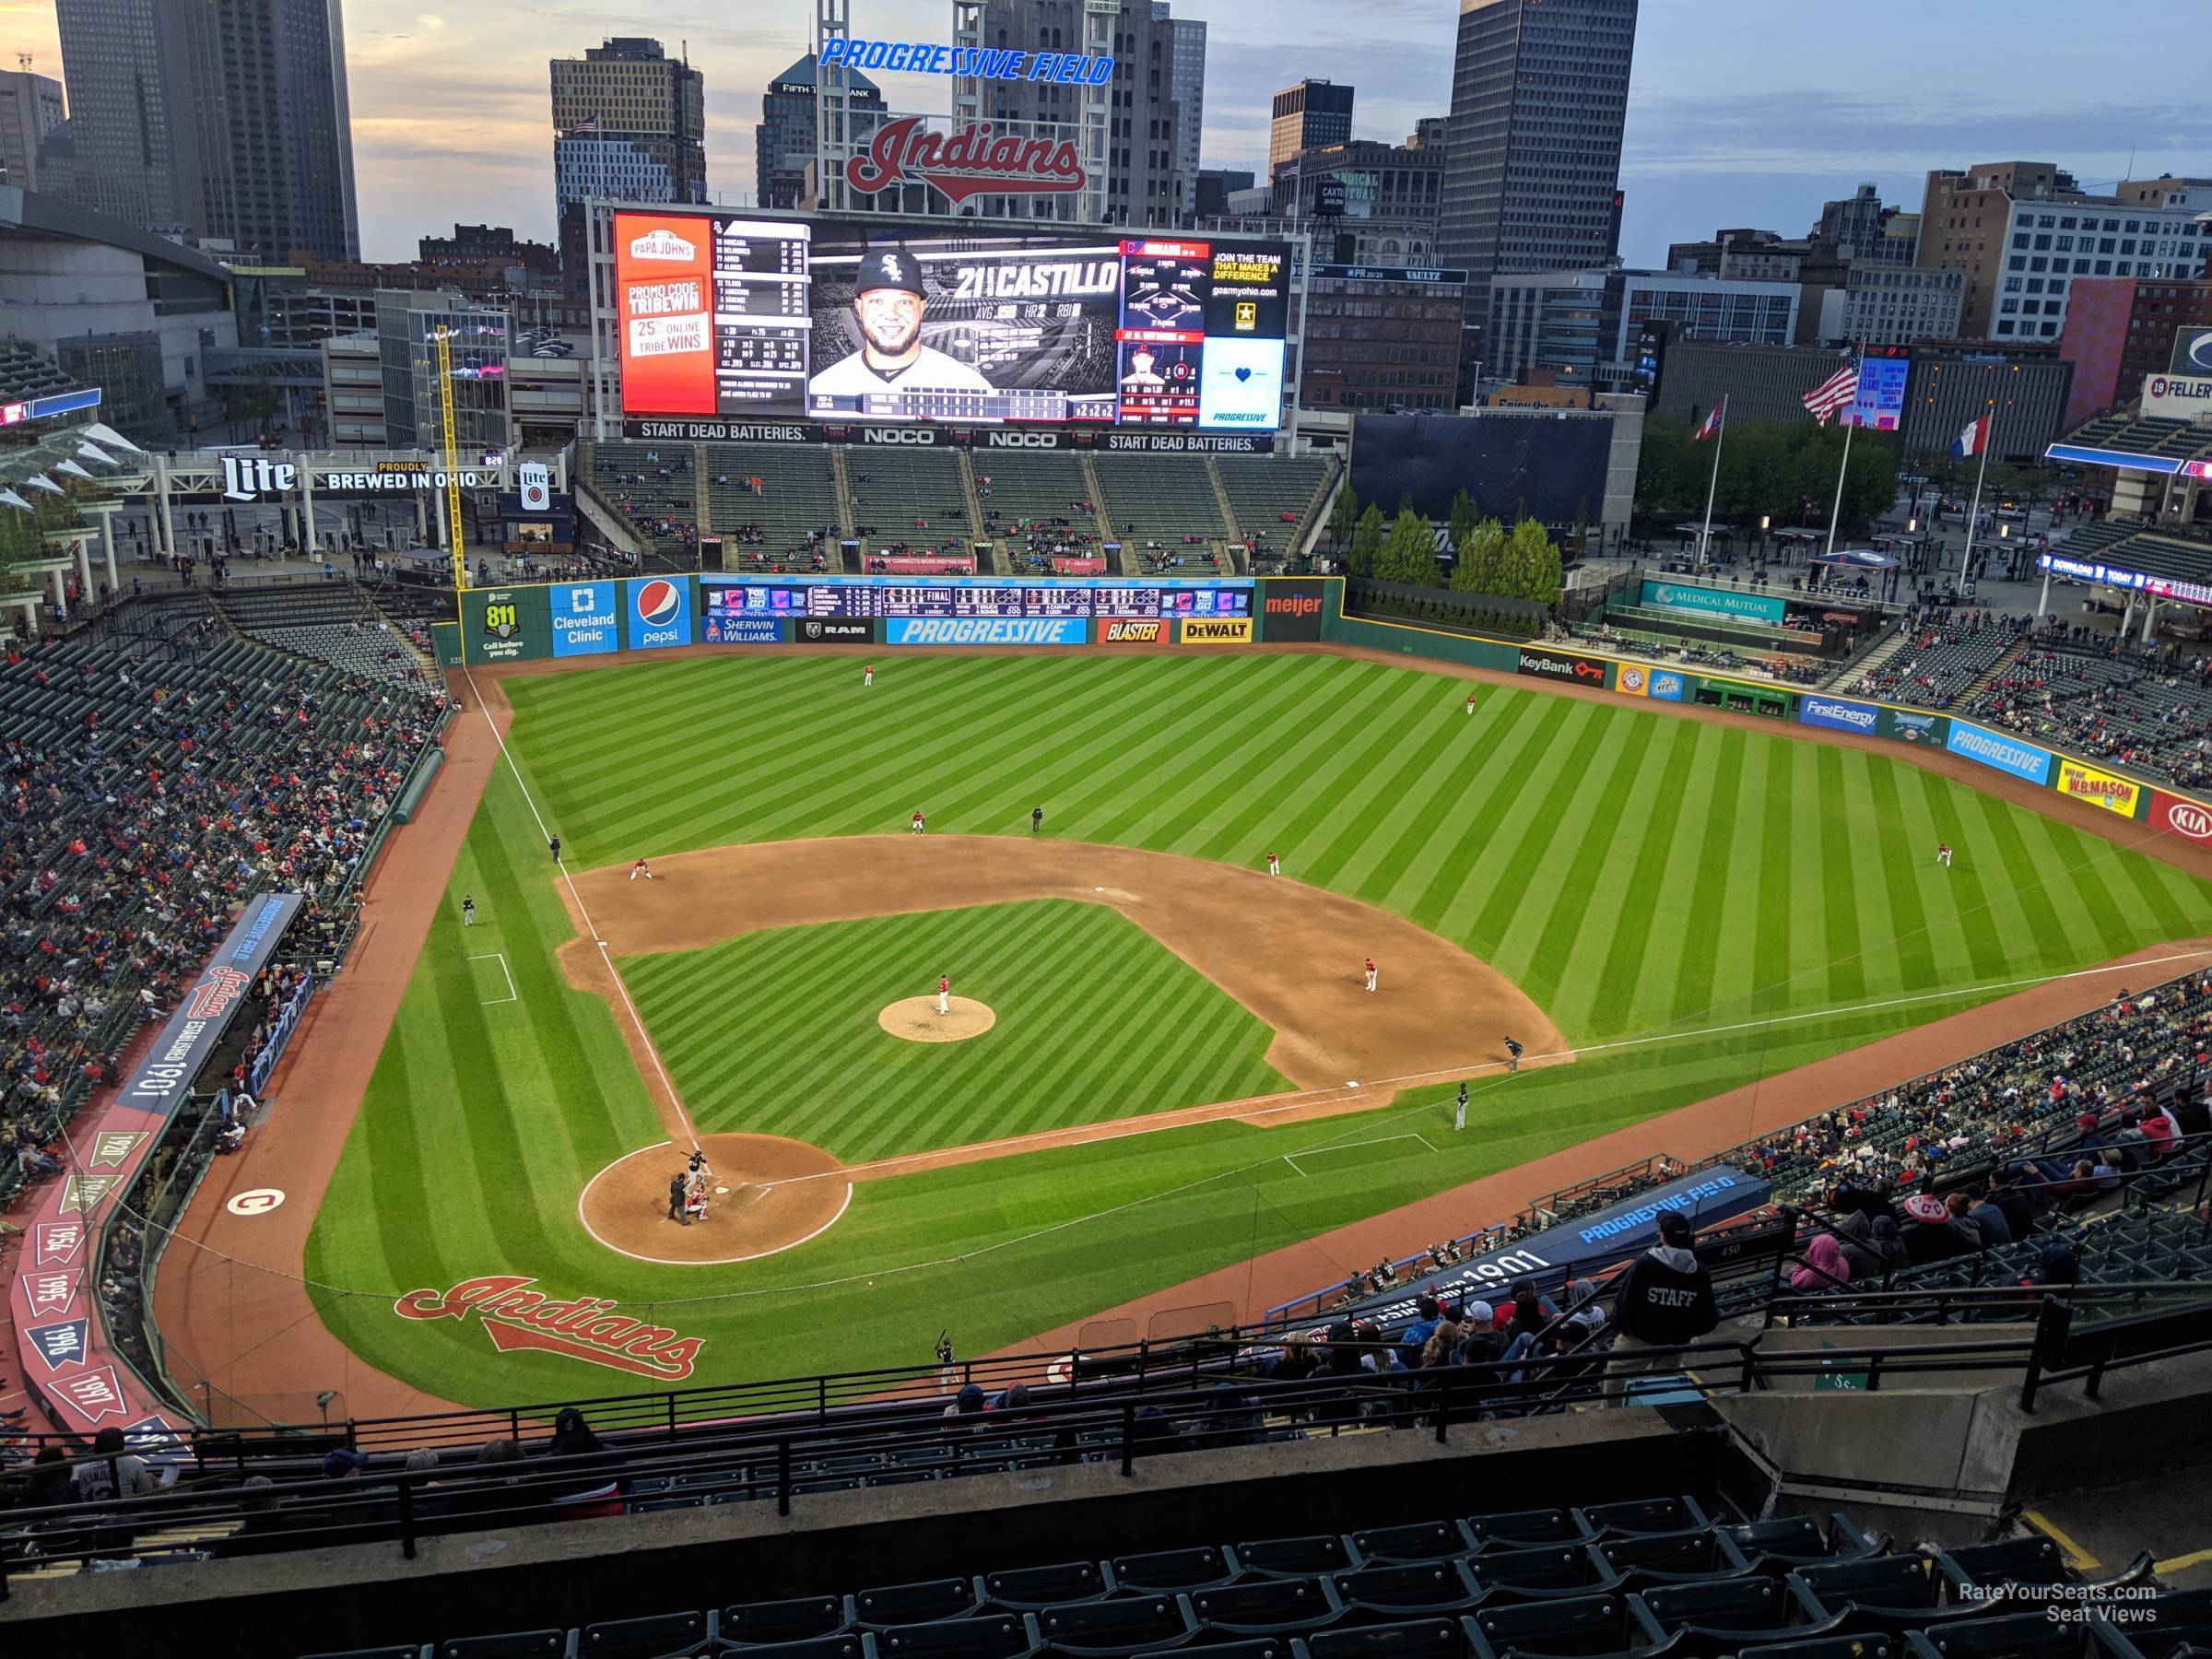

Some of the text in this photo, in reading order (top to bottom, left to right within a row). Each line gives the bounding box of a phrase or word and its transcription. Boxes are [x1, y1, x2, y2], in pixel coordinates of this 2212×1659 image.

[819, 37, 1115, 86] PROGRESSIVE FIELD
[782, 84, 809, 93] FIFTH
[849, 89, 869, 98] ANK
[847, 118, 1086, 194] Indians
[634, 240, 657, 254] PAPA
[1214, 253, 1281, 265] JOIN THE TEAM
[1214, 262, 1278, 273] THAT MAKES A
[954, 267, 985, 299] 21
[995, 261, 1120, 297] CASTILLO
[1354, 268, 1366, 277] PR
[1406, 270, 1441, 281] VAULTZ
[629, 285, 665, 300] PROMO
[1212, 287, 1277, 297] goarmyohio.com
[629, 291, 699, 314] TRIBEWIN
[1025, 303, 1047, 317] HR 2
[1056, 303, 1071, 318] RBI
[975, 306, 993, 320] AVG
[666, 321, 700, 334] ONLINE
[640, 334, 701, 354] TRIBE WINS
[2168, 380, 2212, 399] FELLER
[1499, 398, 1549, 408] Enjoy the
[1213, 413, 1267, 422] PROGRESSIVE
[641, 423, 806, 441] START DEAD BATTERIES.
[865, 429, 935, 444] NOCO
[989, 431, 1057, 448] NOCO
[1110, 436, 1255, 451] START DEAD BATTERIES.
[378, 462, 428, 472] PROUDLY
[220, 457, 295, 501] Lite
[328, 471, 477, 489] BREWED IN OHIO
[523, 471, 546, 485] Lite
[2053, 559, 2133, 582] DOWNLOAD TODAY
[748, 588, 765, 597] FOX
[927, 591, 948, 601] FINAL
[749, 600, 765, 608] GO
[1265, 594, 1322, 617] meijer
[1676, 591, 1770, 614] MEDICAL MUTUAL
[486, 605, 516, 628] 811
[553, 613, 615, 629] Cleveland
[724, 618, 774, 630] SHERWIN
[568, 629, 603, 643] Clinic
[643, 629, 678, 644] pepsi
[724, 629, 776, 641] WILLIAMS
[825, 626, 866, 635] RAM
[900, 618, 1069, 642] PROGRESSIVE
[1107, 622, 1159, 641] BLASTER
[483, 641, 524, 651] Call before
[489, 650, 504, 658] you
[1519, 654, 1573, 676] KeyBank
[1807, 700, 1877, 724] FirstEnergy
[1952, 729, 2043, 774] PROGRESSIVE
[2176, 808, 2206, 833] KIA
[232, 899, 285, 959] PROGRESSIVE FIELD
[188, 967, 250, 1018] Indians
[164, 1021, 206, 1061] ESTABLISHED
[132, 1062, 188, 1097] 1901
[100, 1135, 135, 1156] 1920
[1578, 1175, 1736, 1244] PROGRESSIVE FIELD
[45, 1225, 78, 1252] 1954
[1721, 1244, 1741, 1257] 450
[37, 1274, 67, 1302] 1995
[1647, 1287, 1698, 1307] STAFF
[395, 1275, 705, 1381] Indians
[44, 1325, 75, 1356] 1996
[69, 1375, 115, 1405] 1997
